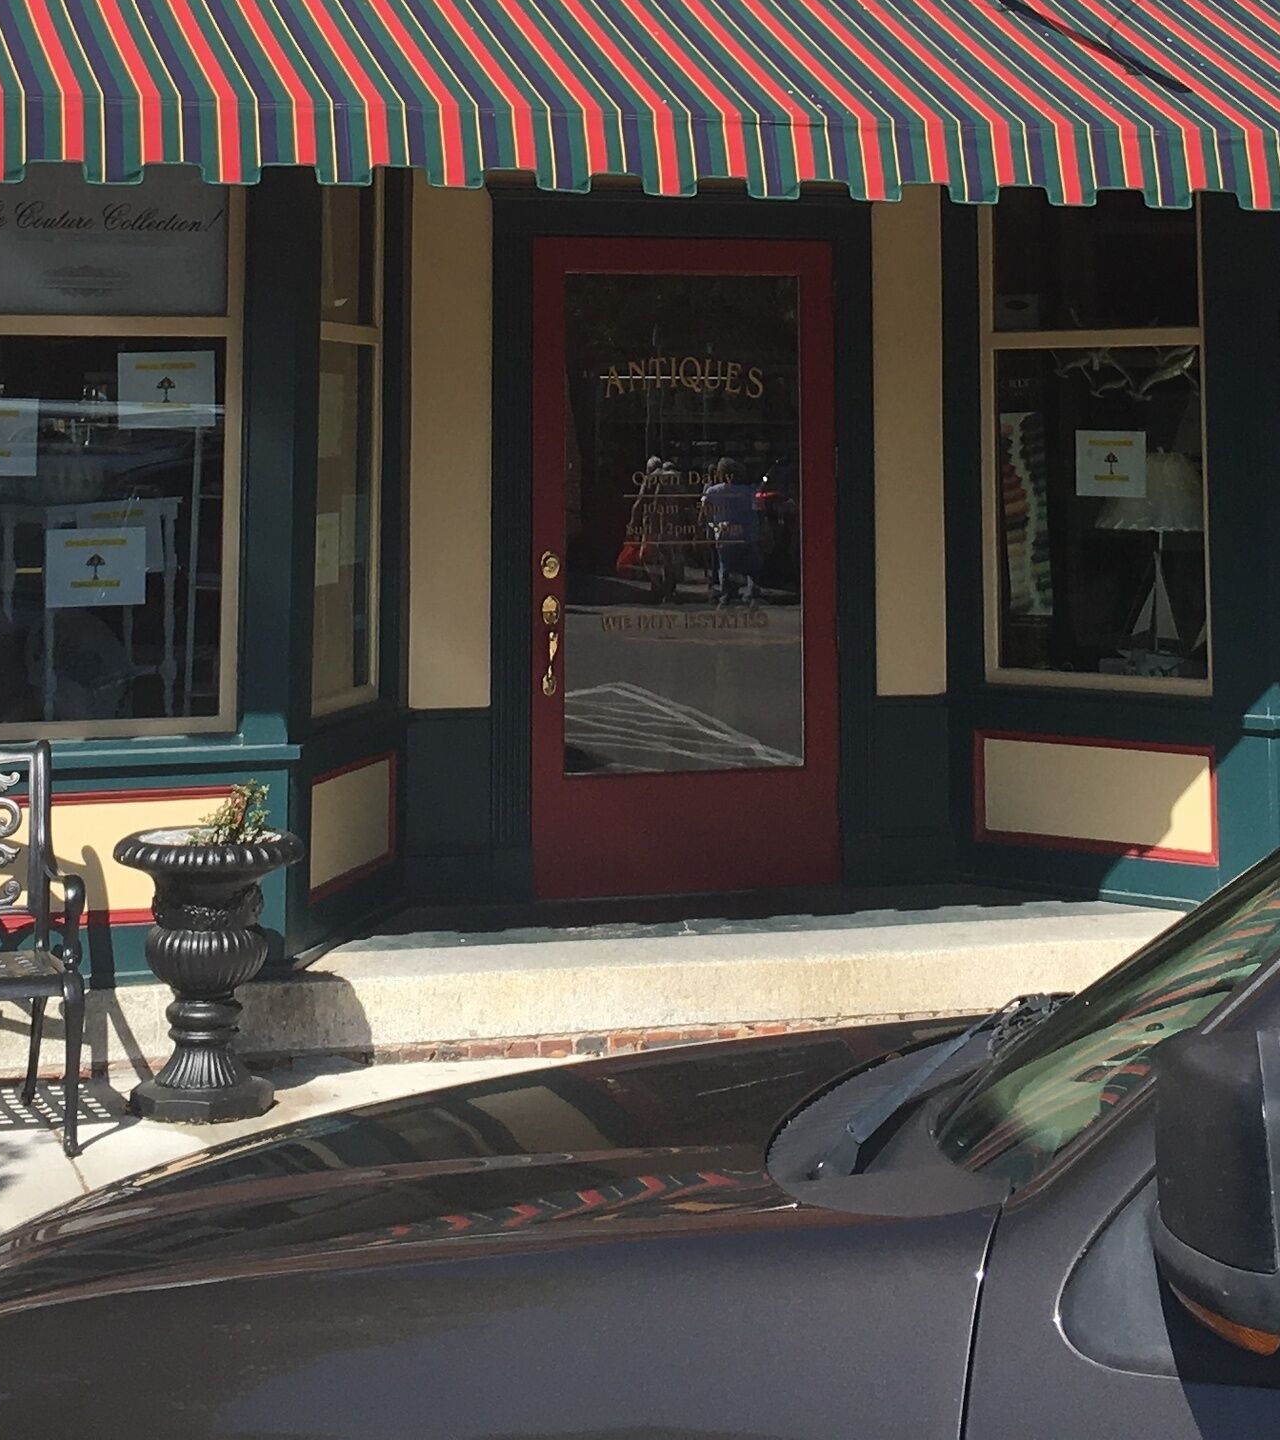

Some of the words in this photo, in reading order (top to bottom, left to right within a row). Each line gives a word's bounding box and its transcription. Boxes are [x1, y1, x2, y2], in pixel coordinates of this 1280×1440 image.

[14, 201, 95, 230] Couture
[102, 203, 225, 233] Collection!
[604, 356, 764, 399] ANTIQUES
[632, 470, 681, 489] Open
[688, 469, 734, 488] Daily
